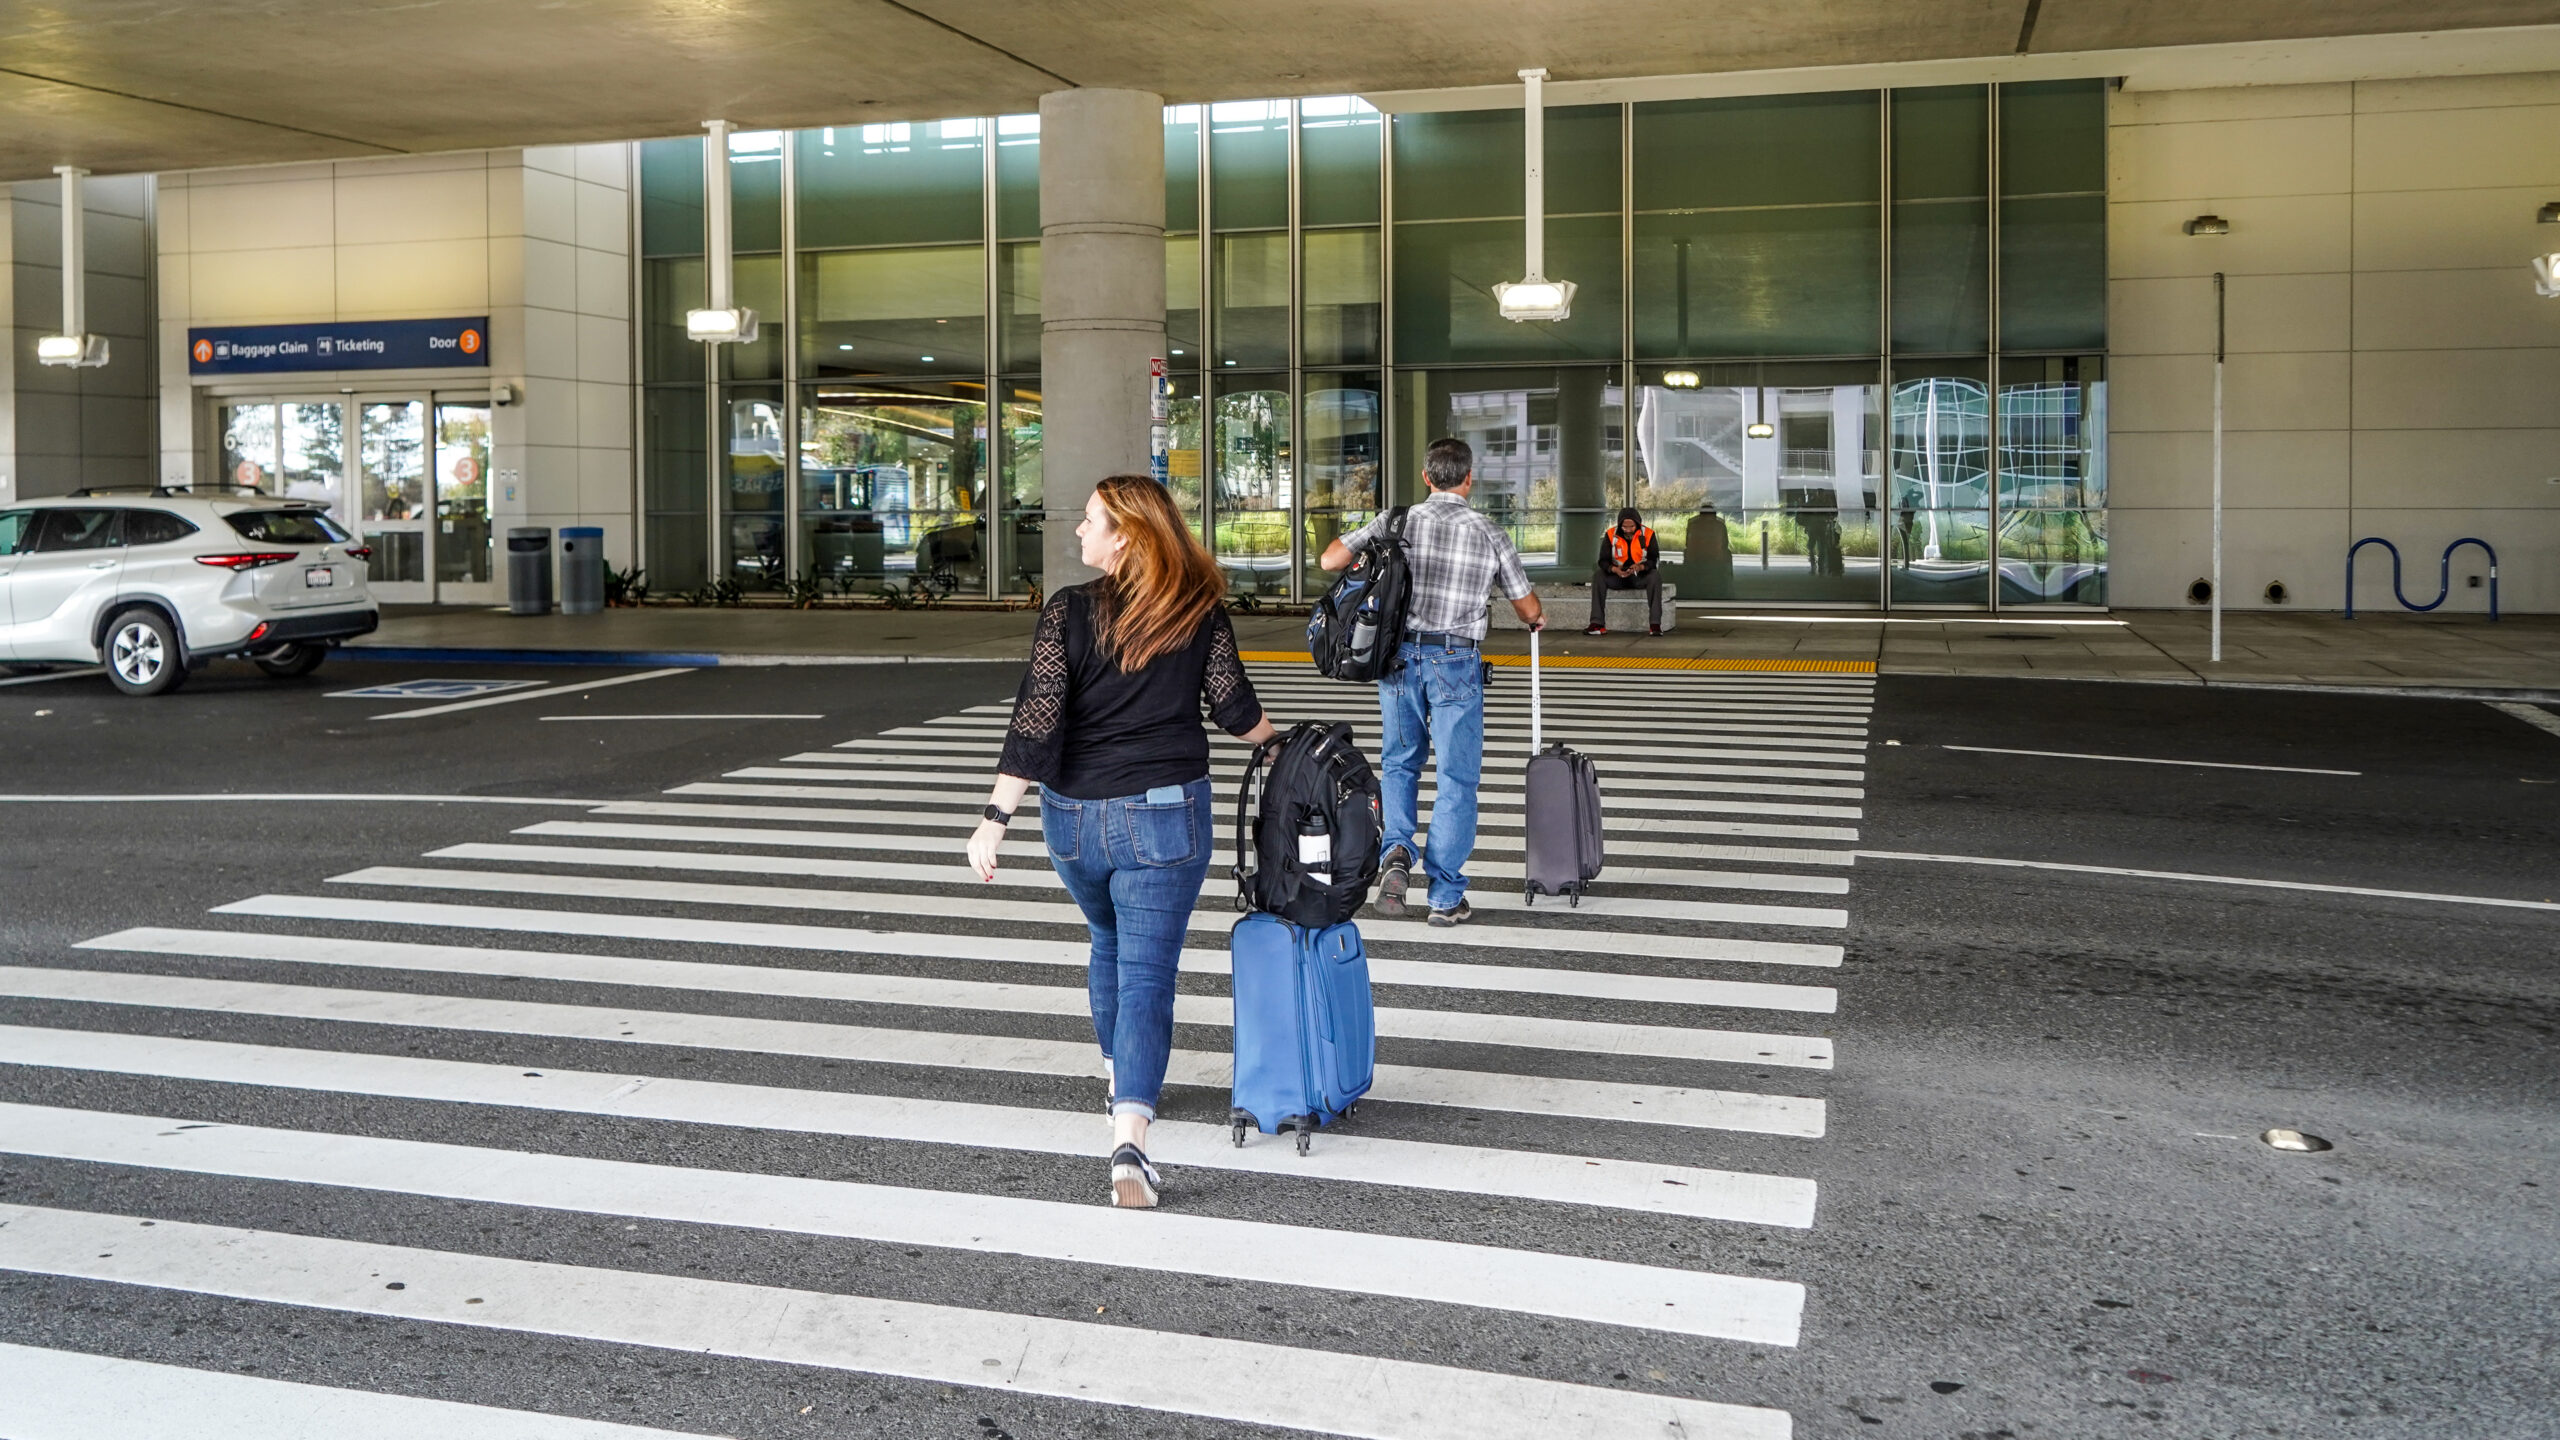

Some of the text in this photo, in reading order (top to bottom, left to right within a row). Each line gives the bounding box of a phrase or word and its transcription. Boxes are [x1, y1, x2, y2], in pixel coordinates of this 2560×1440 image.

[231, 334, 475, 358] Baggage Claim Ticketing Door 3
[243, 463, 257, 485] 3
[459, 459, 473, 482] 3
